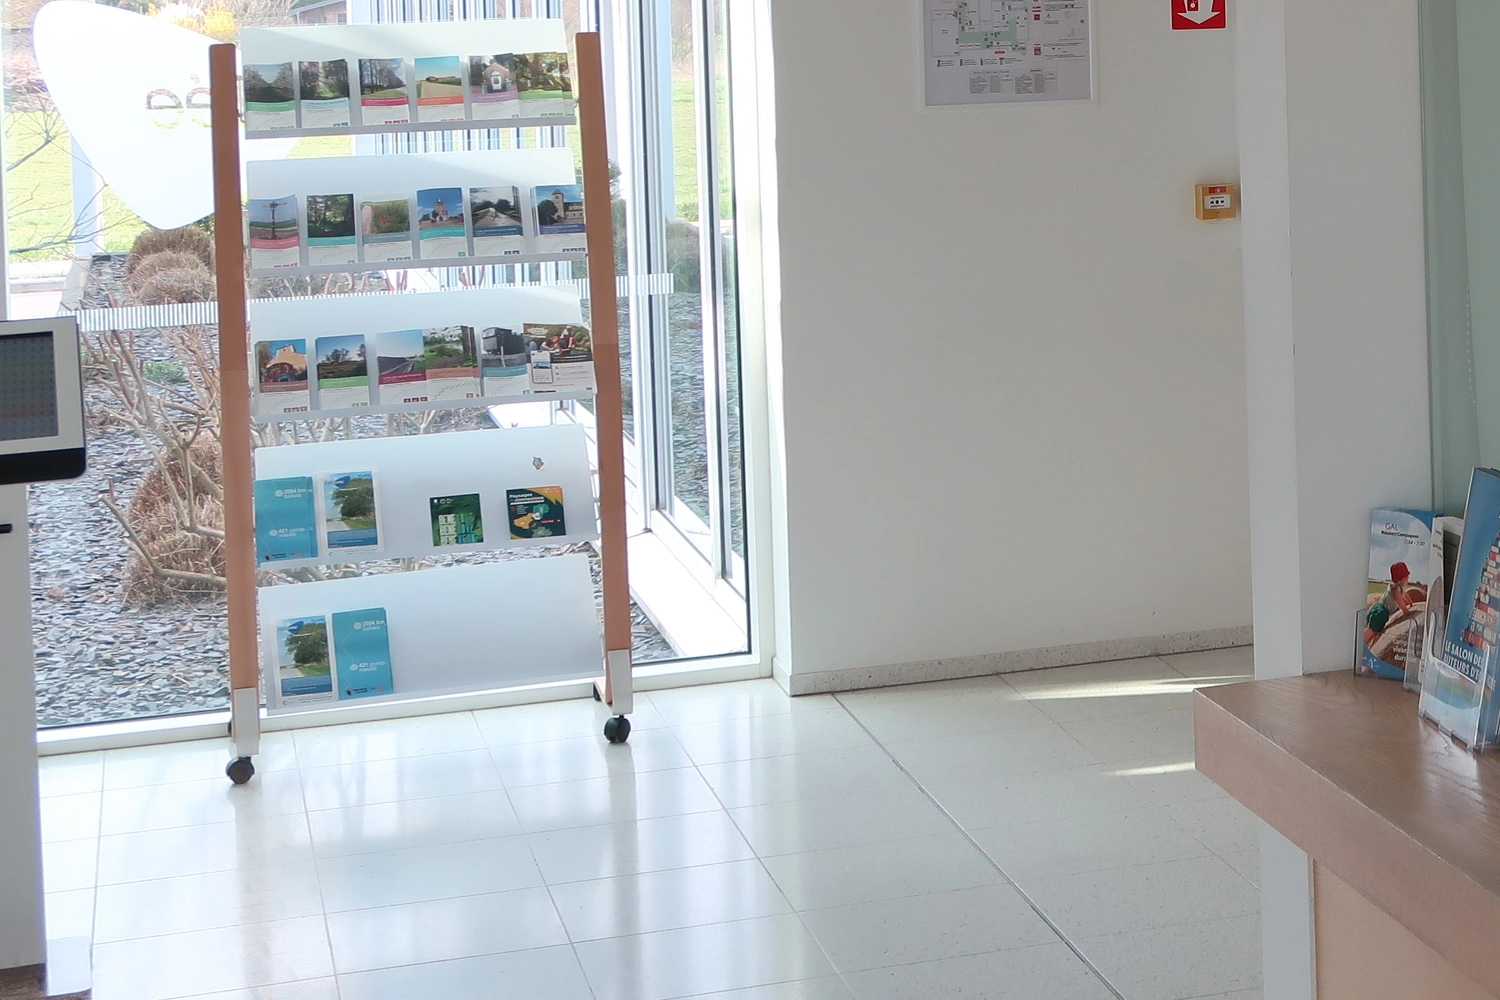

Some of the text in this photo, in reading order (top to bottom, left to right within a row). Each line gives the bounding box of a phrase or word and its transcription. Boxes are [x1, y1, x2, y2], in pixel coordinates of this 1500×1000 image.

[1385, 522, 1399, 531] GAL
[1445, 640, 1451, 653] LE
[1451, 643, 1474, 663] SALON
